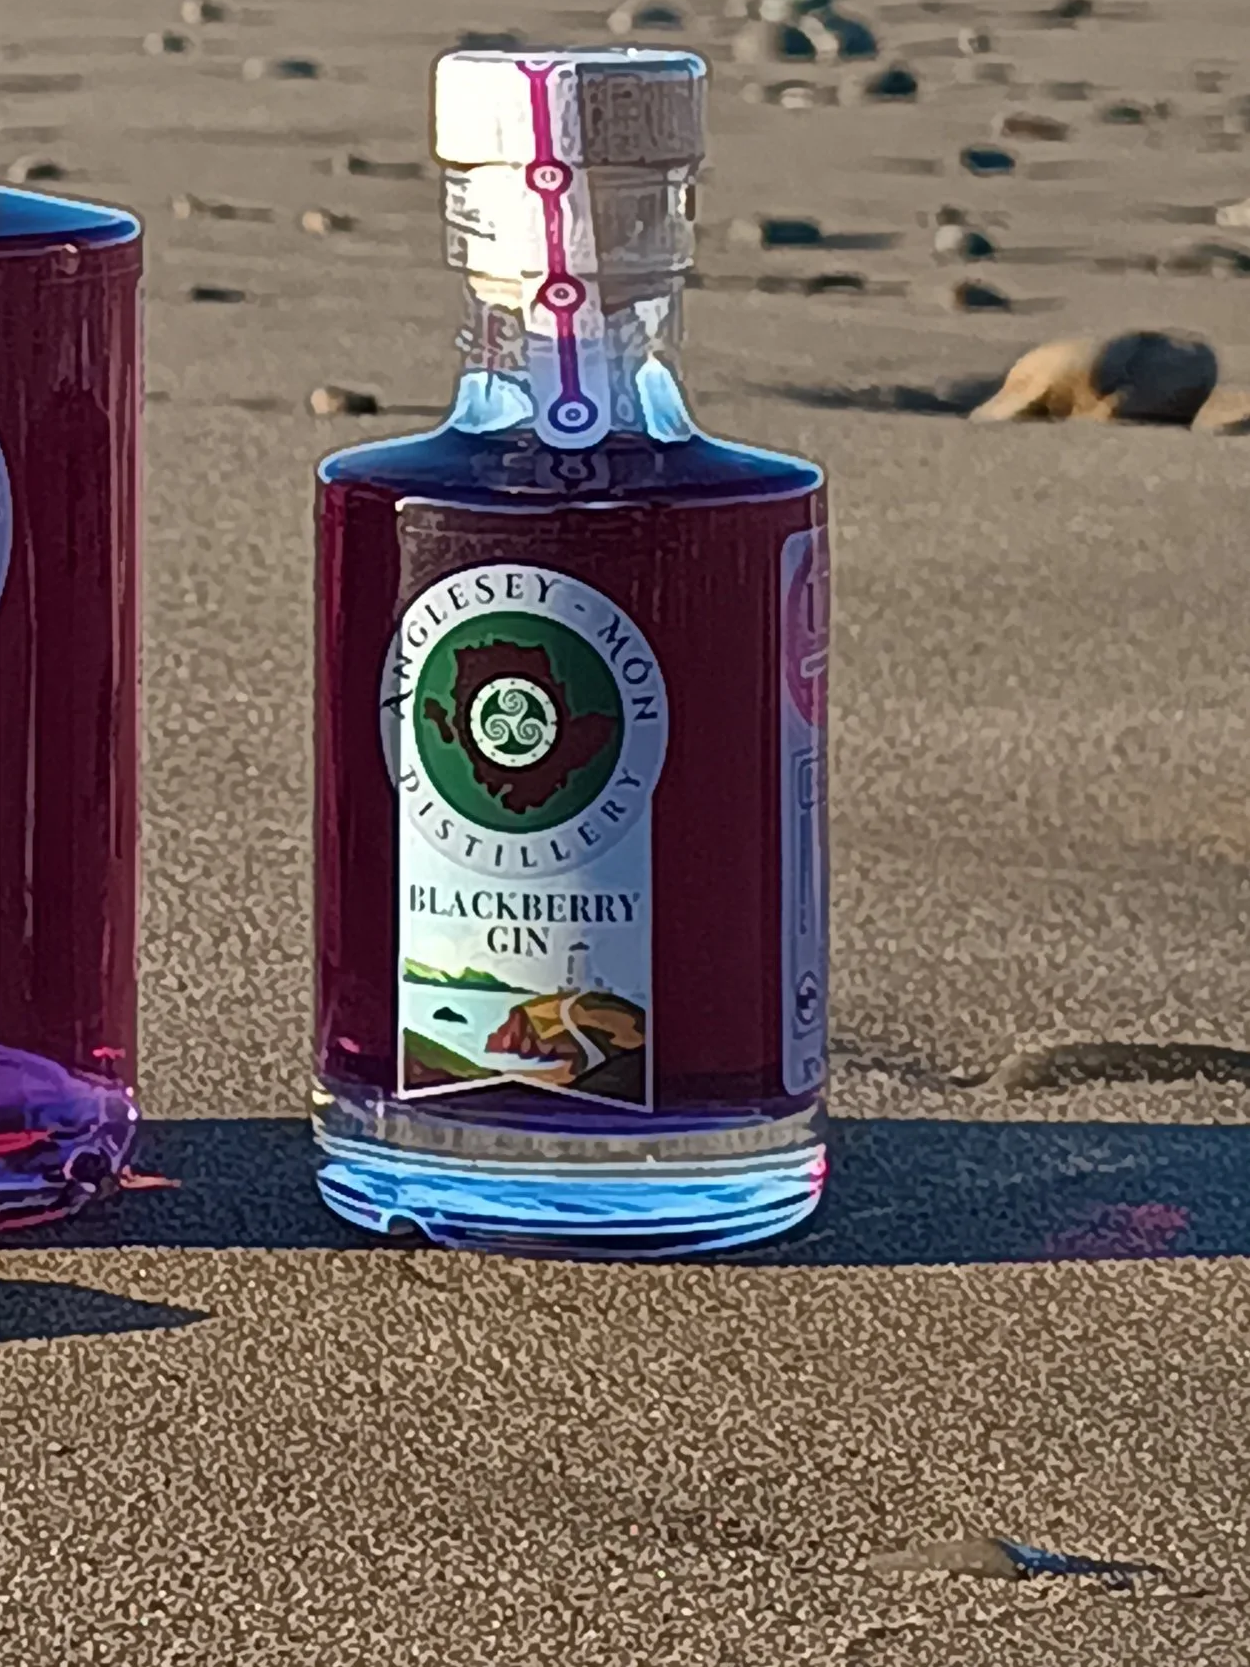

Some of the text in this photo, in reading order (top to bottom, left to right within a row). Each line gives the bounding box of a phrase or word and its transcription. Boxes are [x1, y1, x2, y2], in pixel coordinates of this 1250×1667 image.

[382, 573, 561, 721] ANGLESEY
[399, 765, 642, 868] DISTILLERY
[409, 884, 641, 923] BLACKBERRY
[486, 926, 550, 957] GIN
